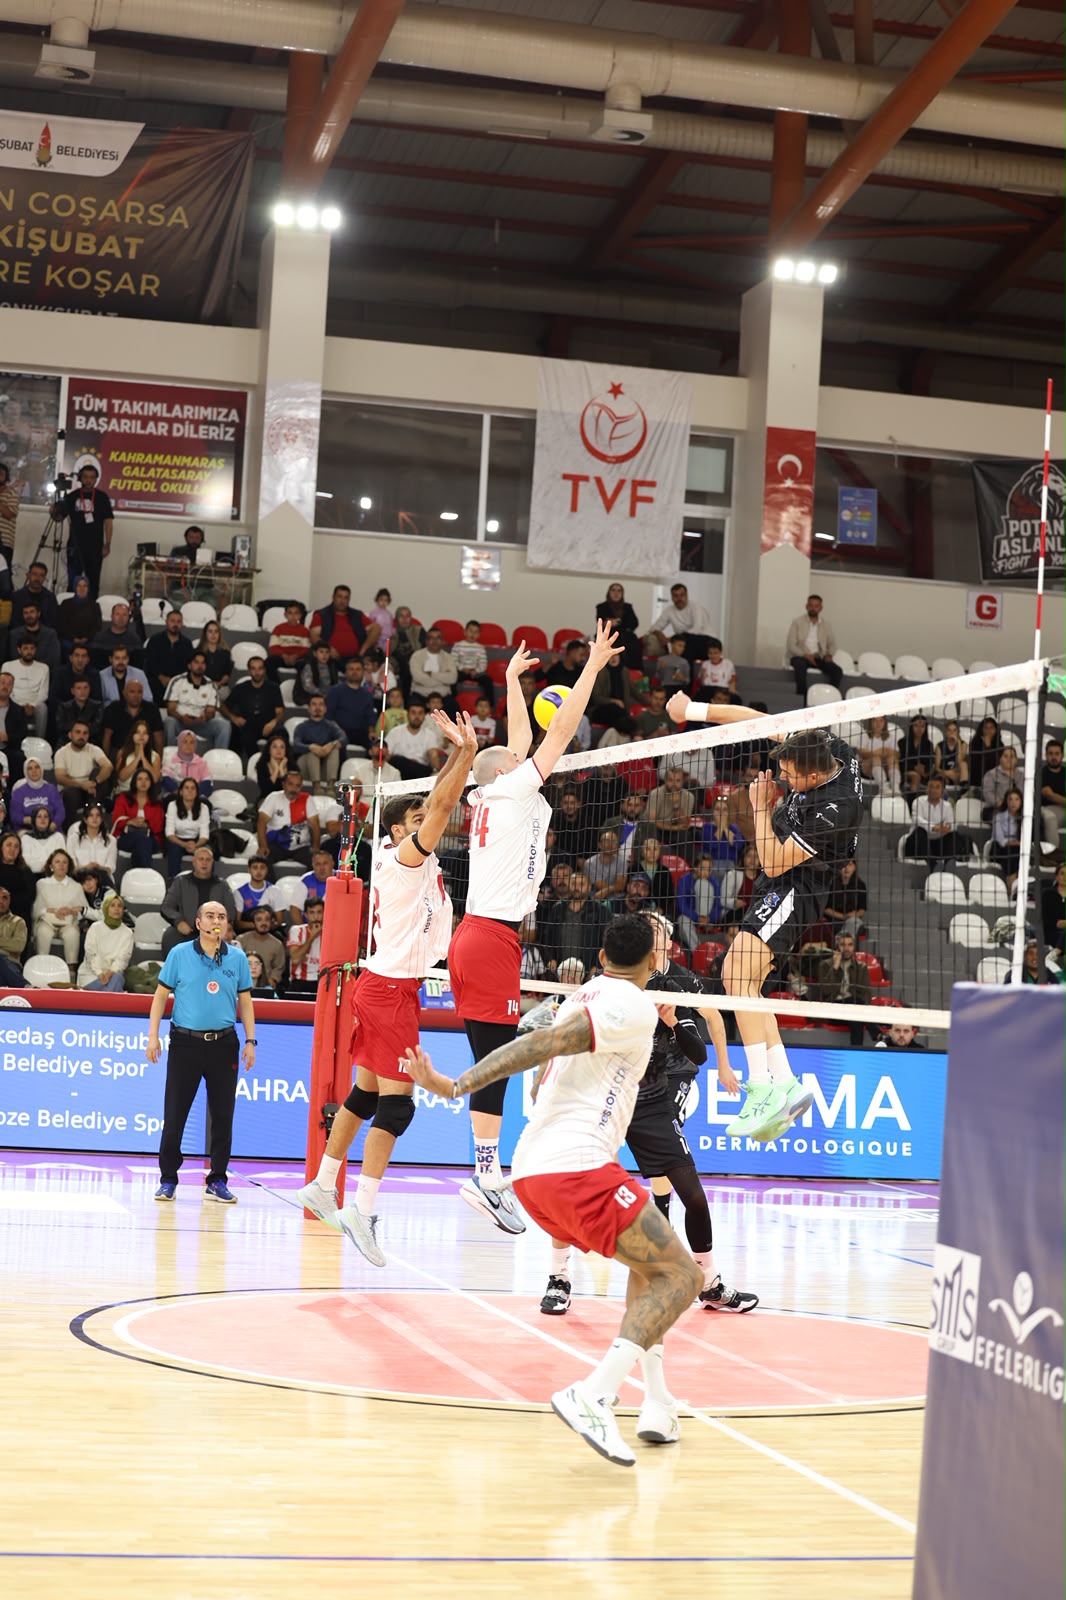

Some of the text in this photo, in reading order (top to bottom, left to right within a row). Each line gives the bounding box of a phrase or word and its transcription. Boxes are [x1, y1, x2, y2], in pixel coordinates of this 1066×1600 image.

[28, 191, 190, 229] COŞARSA
[45, 264, 161, 298] KOŞAR
[72, 394, 240, 423] TÜM TAKIMLARIMIZA
[75, 415, 235, 441] BAŞARILAR DİLERİZ
[109, 451, 225, 470] KAHRAMANMARAŞ
[109, 479, 157, 492] FUTBOL
[122, 466, 212, 482] GALATASARAY
[562, 473, 657, 517] TVF
[976, 594, 997, 620] G
[507, 999, 519, 1016] 14
[4, 1054, 149, 1080] Belediye Spor
[37, 1110, 127, 1134] Belediye
[699, 1135, 913, 1157] DERMATOLOGIQUE
[614, 1184, 638, 1209] 13
